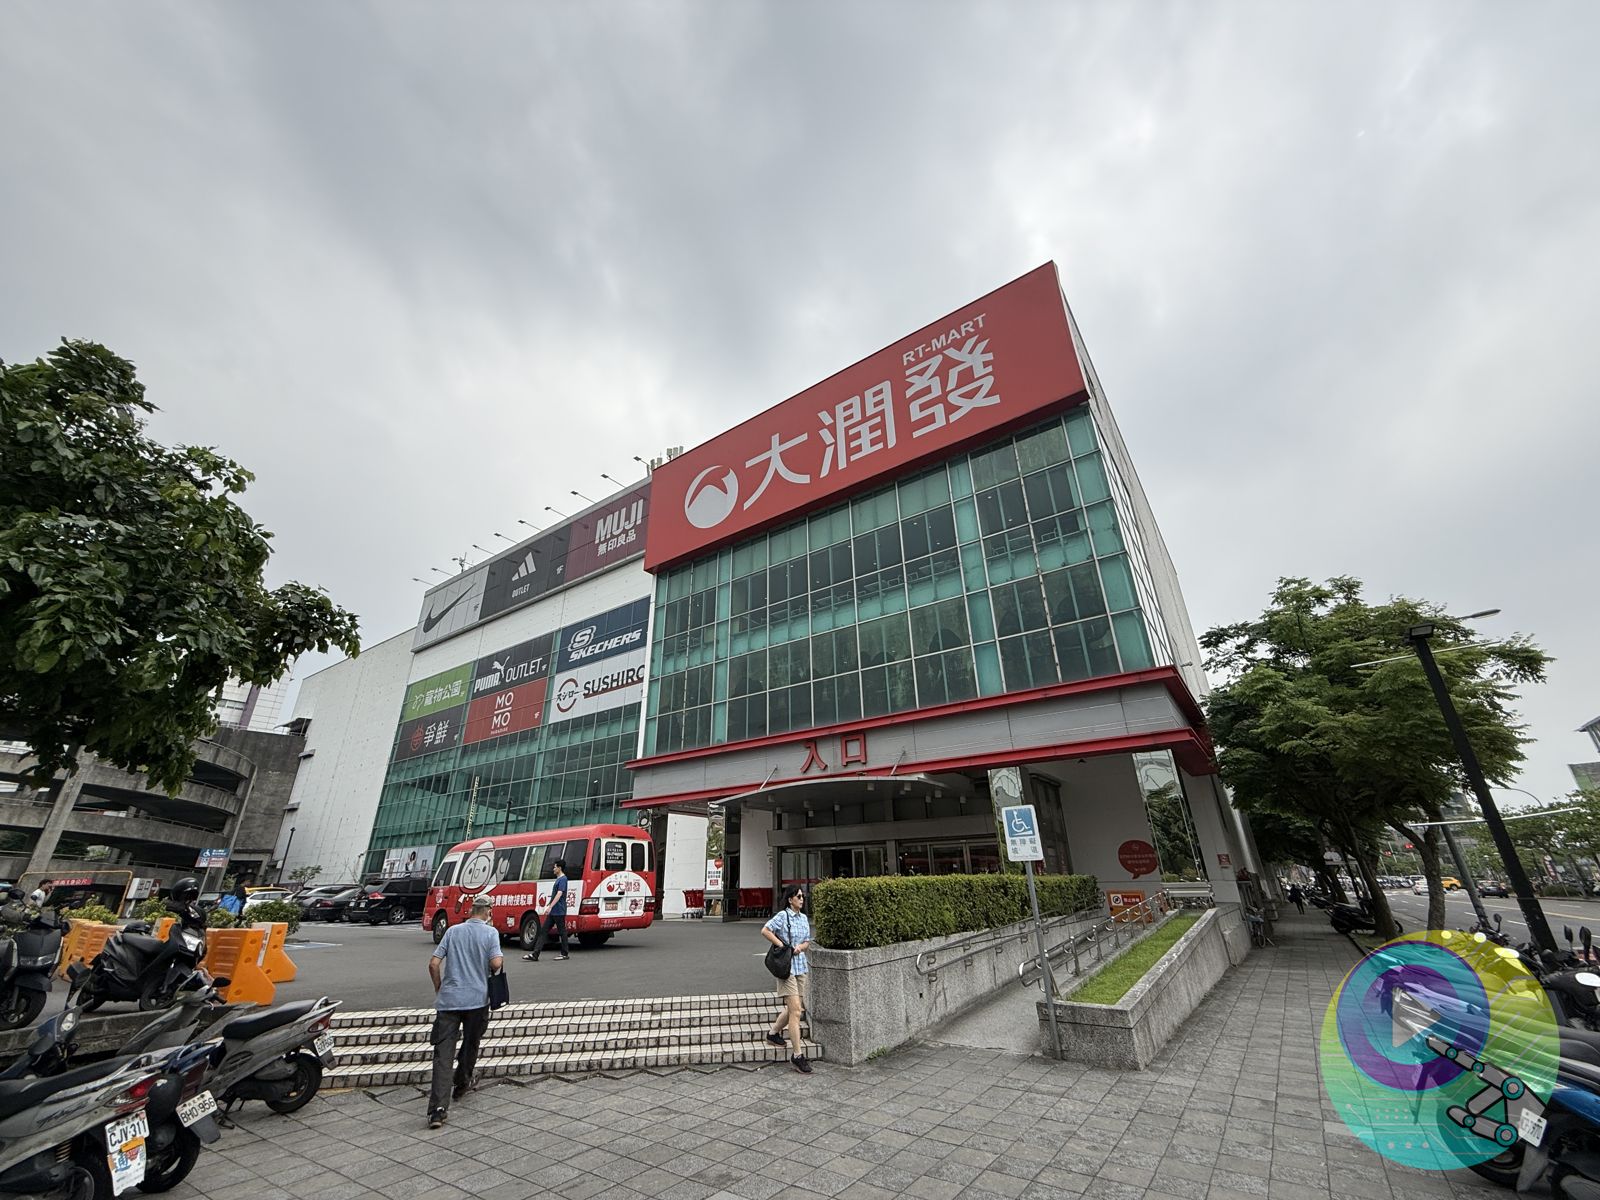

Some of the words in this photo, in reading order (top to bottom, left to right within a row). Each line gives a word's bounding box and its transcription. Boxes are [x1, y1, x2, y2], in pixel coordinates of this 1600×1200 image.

[903, 313, 986, 366] RT-MART
[743, 334, 1000, 511] 大潤發
[595, 499, 643, 544] MUJI
[597, 529, 637, 556] 無印良品
[511, 584, 530, 598] OUTLET
[569, 629, 643, 662] SKECHERS
[474, 672, 501, 693] PUMA
[505, 658, 543, 683] OUTLET
[424, 680, 462, 707] 寵物公園
[495, 692, 514, 710] MO
[556, 689, 579, 702] スシロー
[424, 720, 449, 747] 爭鮮
[491, 712, 511, 730] MO
[800, 733, 867, 773] 入口
[109, 1119, 147, 1147] CJV-311
